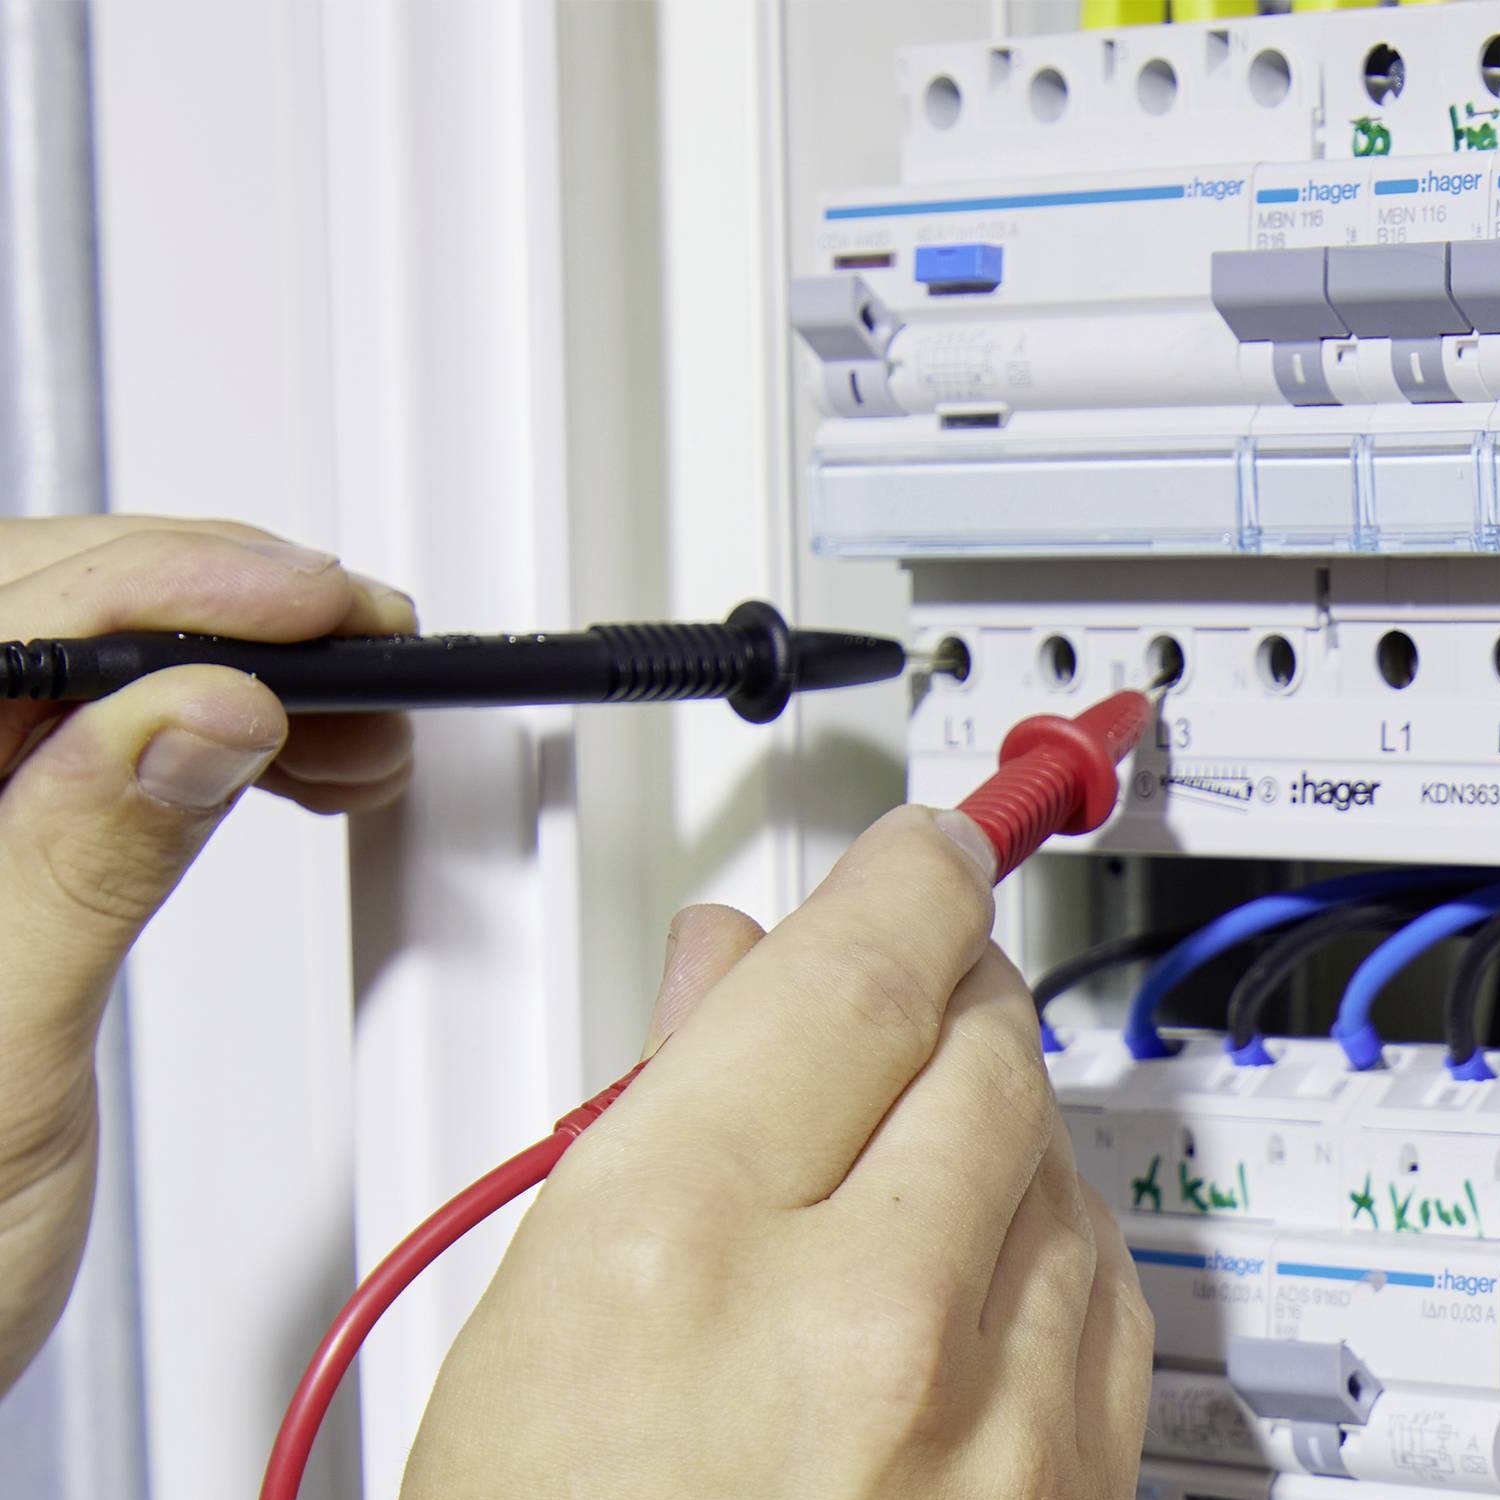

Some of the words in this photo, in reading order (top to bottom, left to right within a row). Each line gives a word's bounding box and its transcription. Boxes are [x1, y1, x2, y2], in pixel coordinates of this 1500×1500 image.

[944, 718, 974, 746] L1
[1156, 718, 1192, 749] L3
[1380, 721, 1412, 752] L1
